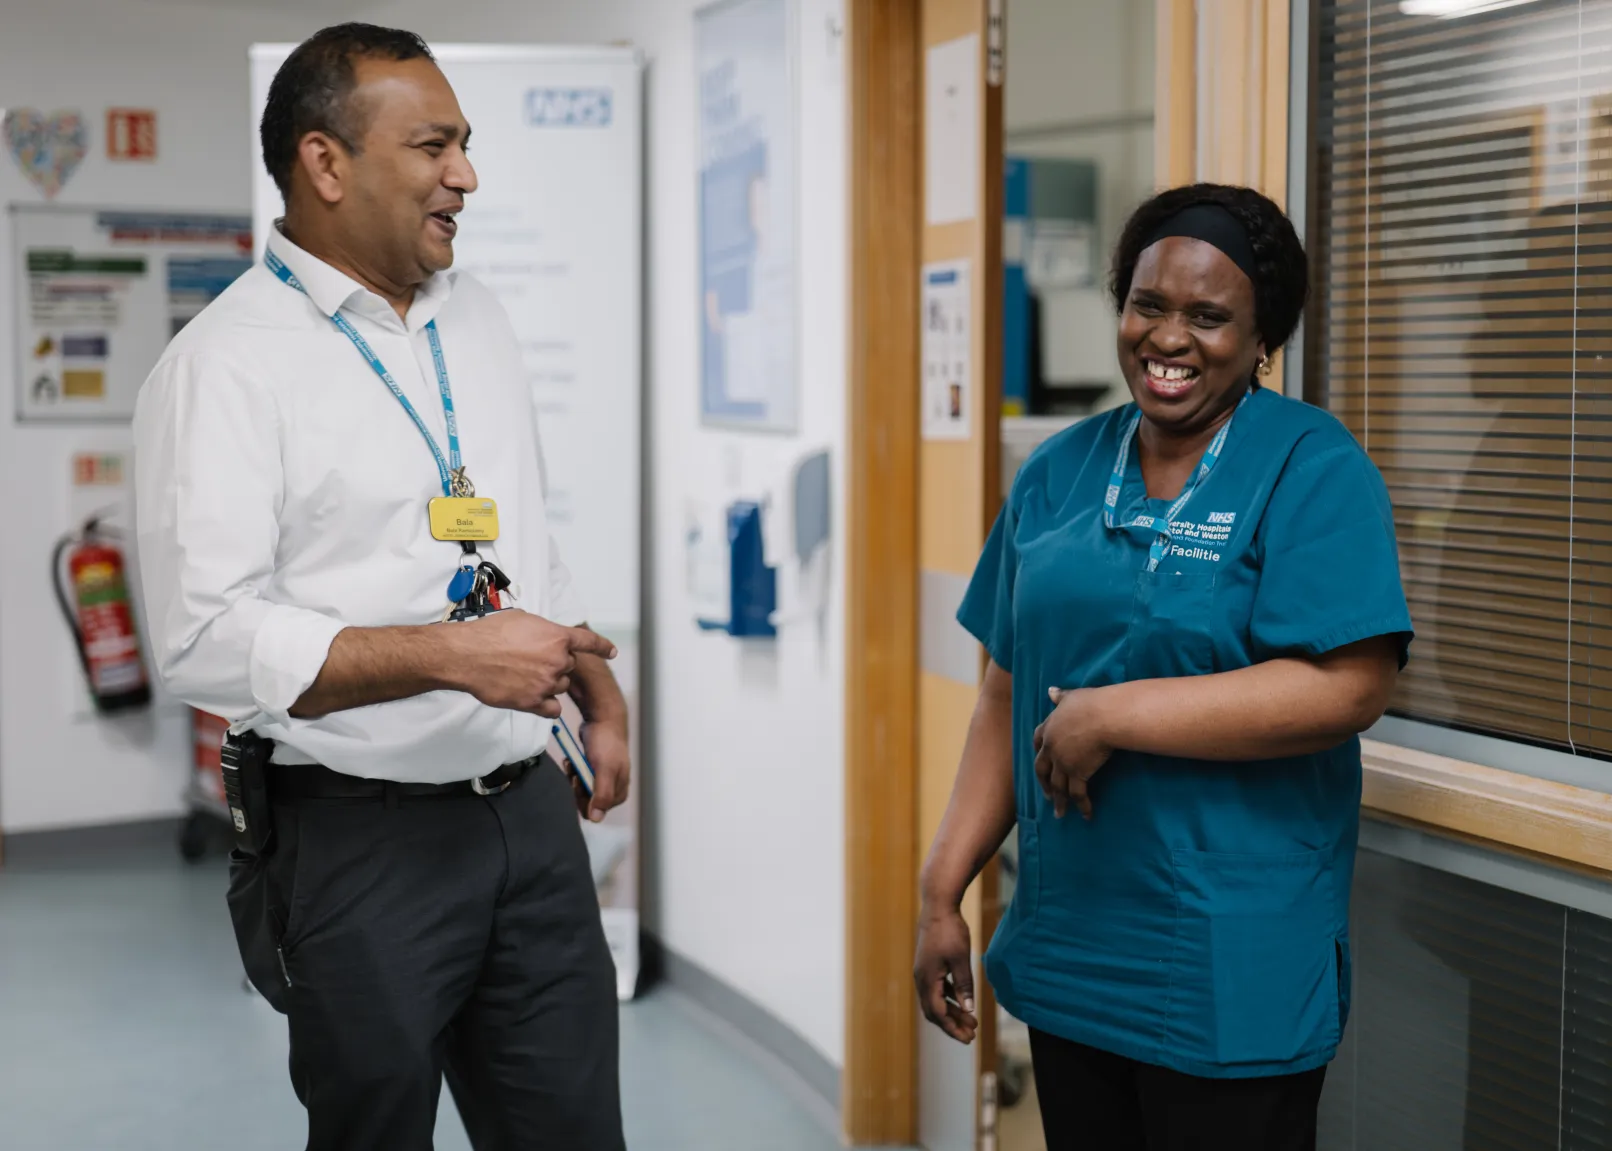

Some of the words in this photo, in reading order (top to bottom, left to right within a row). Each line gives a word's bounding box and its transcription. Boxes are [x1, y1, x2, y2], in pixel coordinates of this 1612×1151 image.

[524, 87, 614, 127] NHS
[456, 518, 474, 526] Bala
[1132, 516, 1154, 528] NHS
[1207, 512, 1236, 523] NHS
[1197, 524, 1231, 533] Hospitals
[1184, 530, 1199, 538] and
[1202, 532, 1228, 540] Weston
